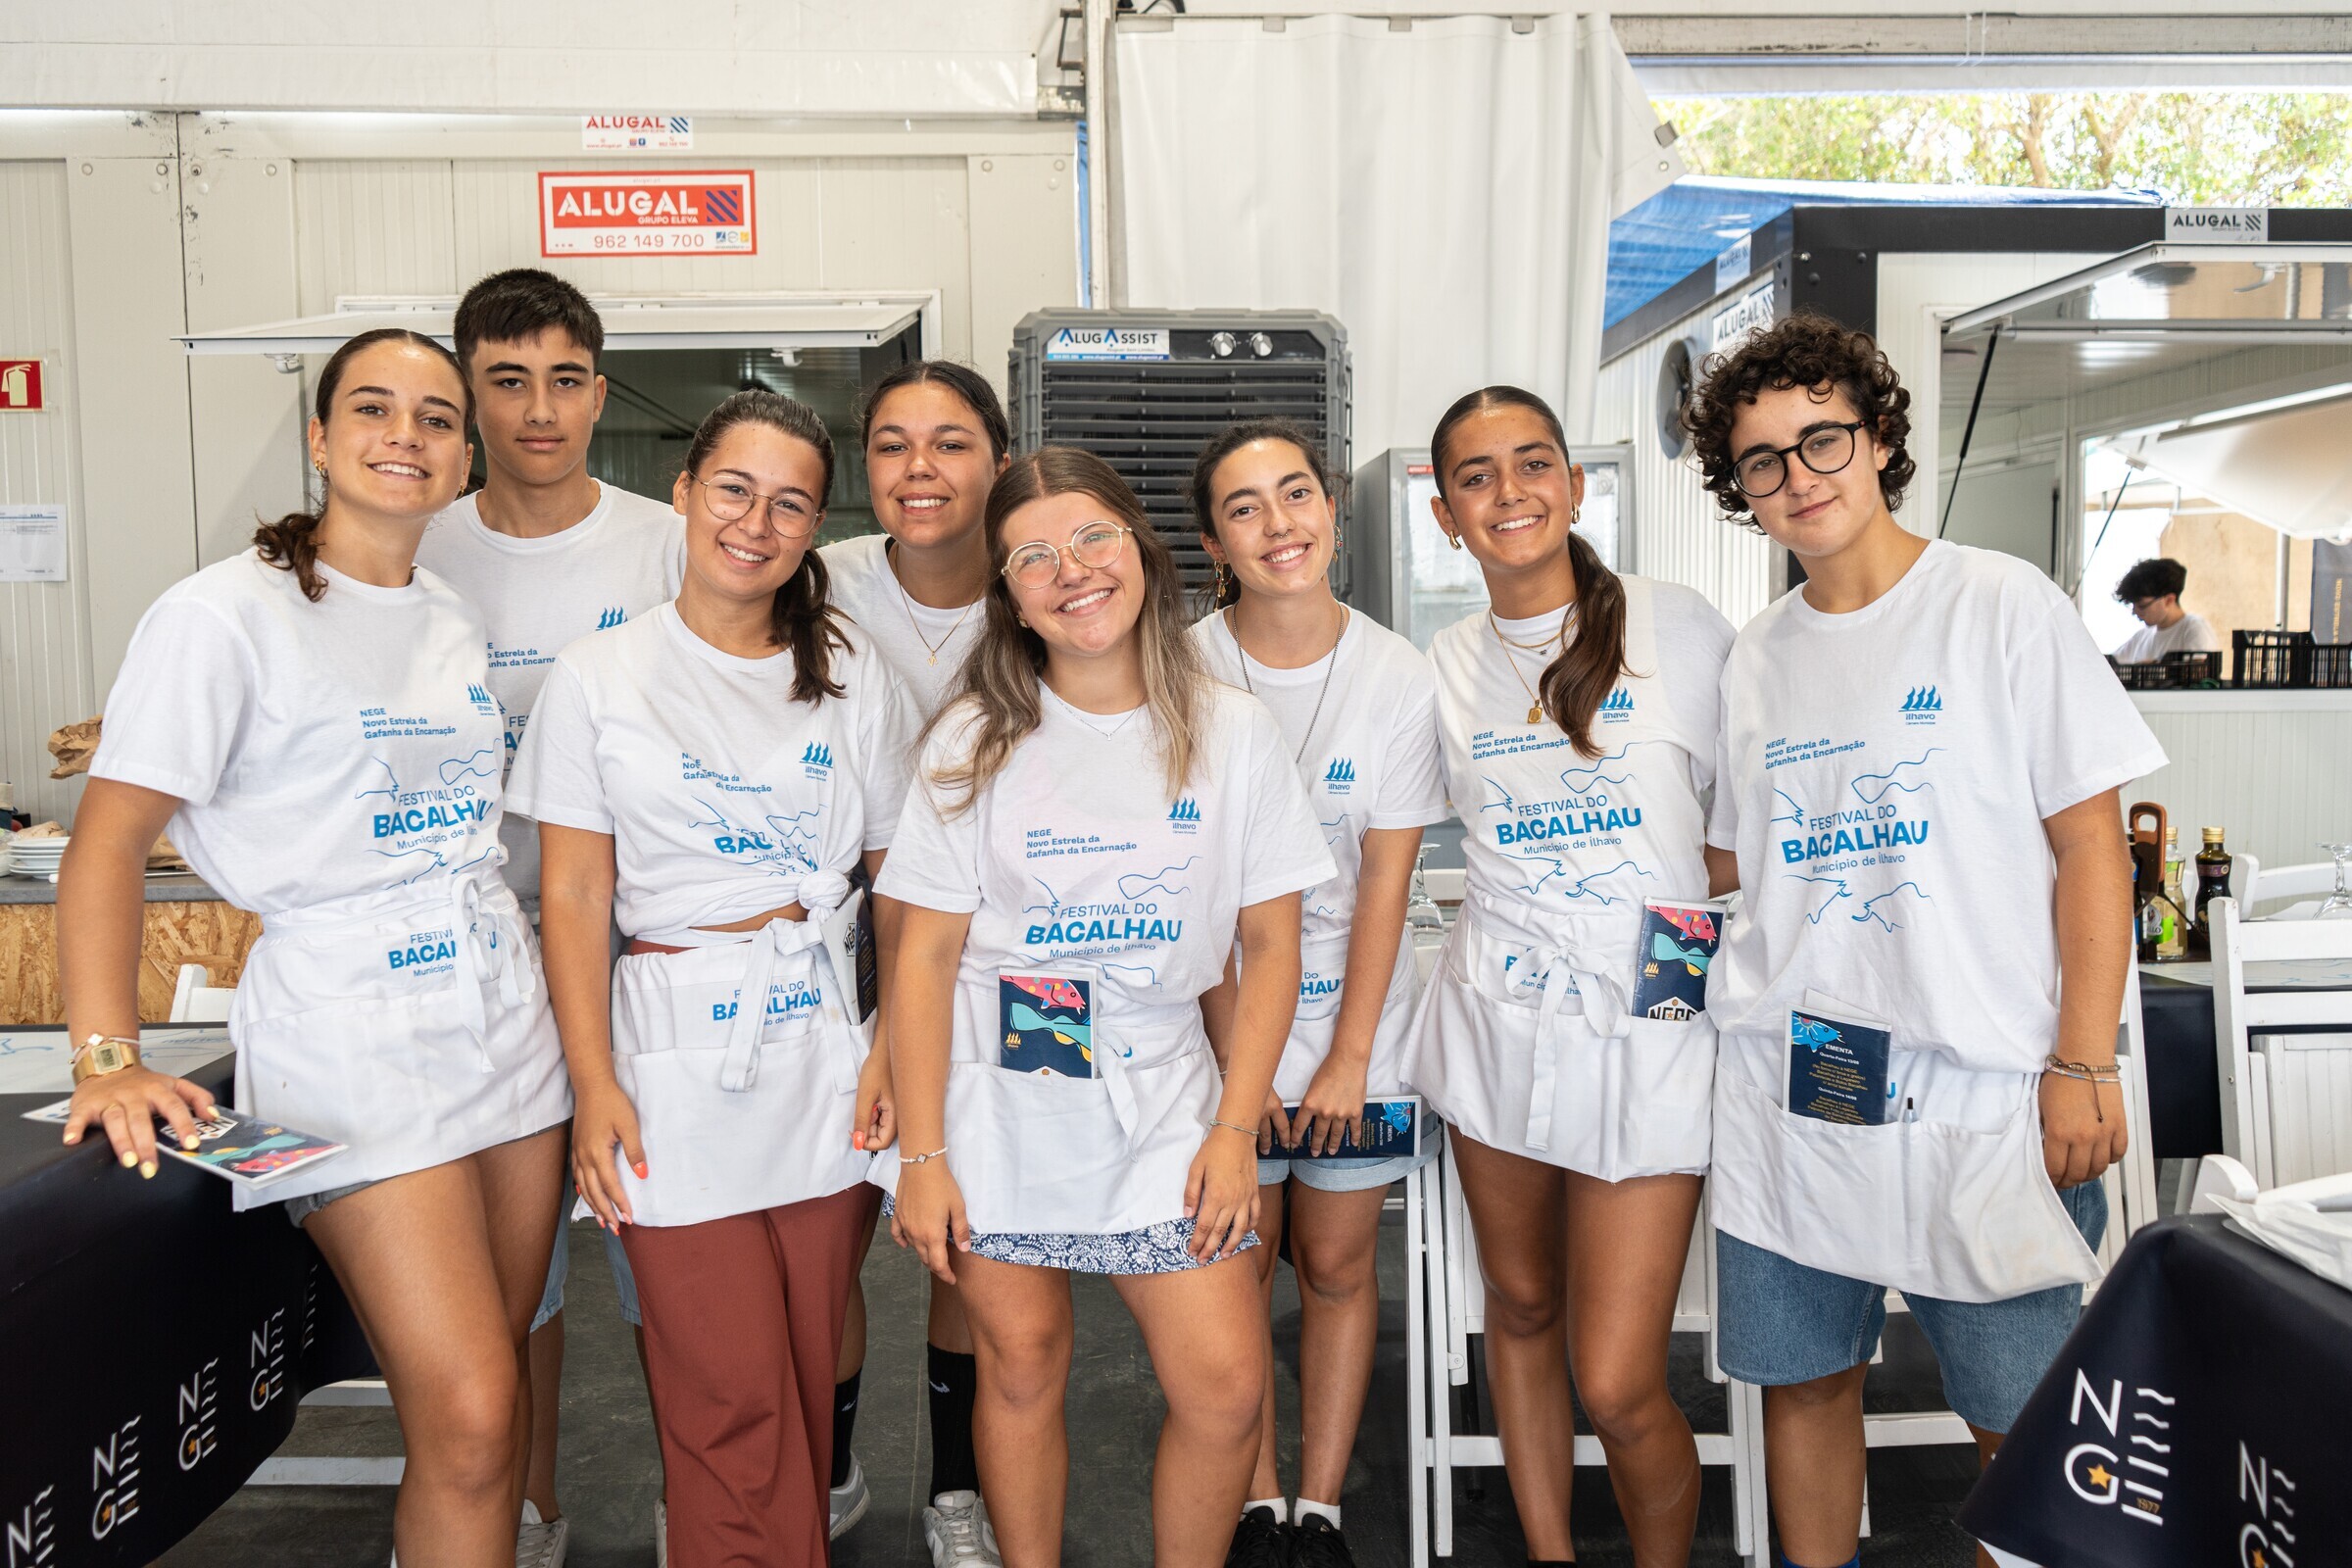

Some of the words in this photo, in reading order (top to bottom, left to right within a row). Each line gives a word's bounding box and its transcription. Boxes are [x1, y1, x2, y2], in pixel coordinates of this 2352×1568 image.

[586, 116, 665, 128] ALUGAL
[557, 190, 699, 217] ALUGAL
[638, 216, 669, 224] GRUPO
[670, 215, 699, 223] ELEVA
[2173, 214, 2241, 226] ALUGAL
[594, 234, 626, 249] 962
[633, 234, 664, 248] 149
[671, 234, 705, 248] 700
[1718, 301, 1759, 342] ALUGAL
[494, 649, 525, 659] Estrela
[522, 657, 556, 665] Encarna
[360, 708, 387, 717] NEGE
[363, 718, 387, 728] Novo
[389, 716, 416, 726] Estrela
[418, 716, 428, 725] da
[364, 728, 403, 740] Gafanha
[404, 727, 414, 736] da
[415, 725, 457, 737] Encarnação
[1472, 731, 1494, 742] NEGE
[1494, 736, 1523, 747] Estrela
[1766, 738, 1787, 750] NEGE
[1472, 748, 1505, 760] Gafanha
[1520, 737, 1570, 752] Encarnação
[1765, 750, 1784, 760] Novo
[1786, 743, 1816, 754] Estrela
[1819, 738, 1830, 747] da
[1765, 757, 1797, 769] Gafanha
[1799, 753, 1811, 761] da
[1813, 740, 1865, 759] Encarnação
[398, 789, 453, 807] FESTIVAL
[454, 785, 475, 799] DO
[1518, 798, 1584, 816] FESTIVAL
[1587, 795, 1607, 808] DO
[1810, 808, 1874, 831] FESTIVAL
[1878, 805, 1896, 819] DO
[1495, 808, 1642, 845] BACALHAU
[451, 829, 466, 839] de
[1027, 829, 1053, 839] NEGE
[1027, 840, 1049, 849] Novo
[1052, 837, 1086, 846] Estrela
[1524, 842, 1569, 855] Município
[1572, 840, 1587, 849] de
[1782, 820, 1929, 863] BACALHAU
[1026, 848, 1065, 858] Gafanha
[1067, 846, 1079, 855] da
[1081, 842, 1137, 855] Encarnação
[1862, 856, 1876, 866] de
[1059, 904, 1130, 918] FESTIVAL
[1134, 903, 1157, 915] DO
[1025, 918, 1183, 945] BACALHAU
[1050, 947, 1103, 958] Município
[1107, 945, 1121, 954] de
[789, 981, 805, 992] DO
[1825, 1044, 1854, 1055] EMENTA
